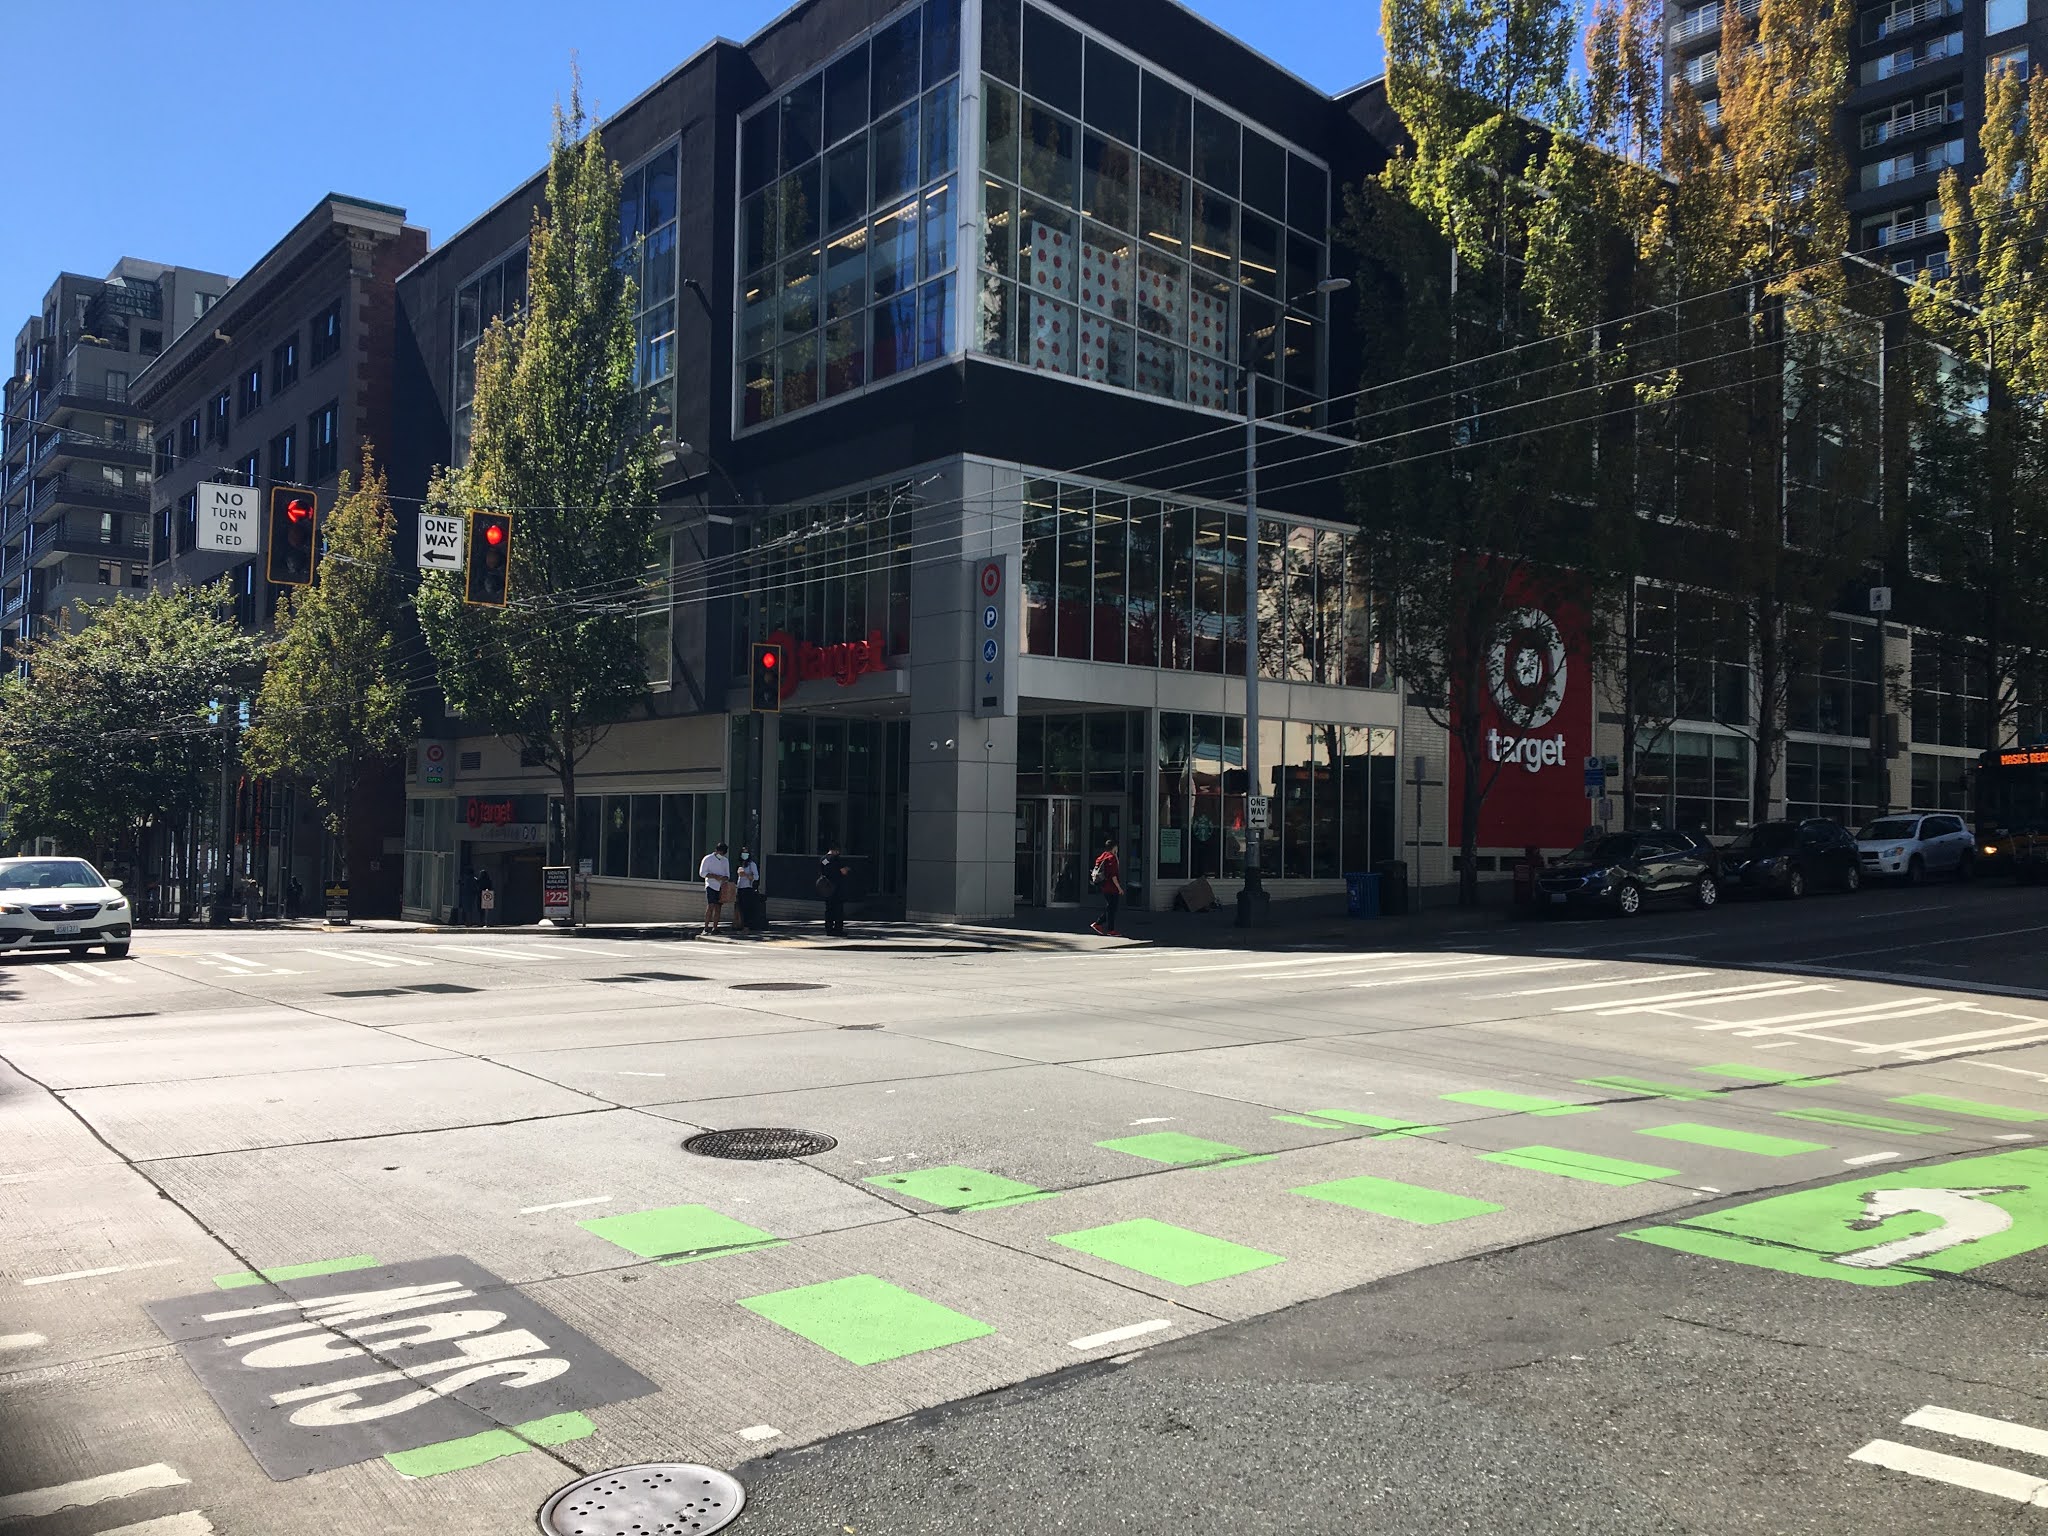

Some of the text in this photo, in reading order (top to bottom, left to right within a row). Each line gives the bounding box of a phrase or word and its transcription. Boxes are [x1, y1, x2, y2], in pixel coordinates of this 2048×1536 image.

[215, 491, 244, 506] NO
[211, 506, 247, 520] TURN
[219, 521, 238, 533] ON
[424, 519, 458, 534] ONE
[215, 534, 242, 546] RED
[425, 533, 459, 548] WAY
[986, 611, 995, 626] P
[799, 629, 888, 688] target
[1486, 727, 1567, 773] target
[2001, 754, 2028, 765] MASKS
[1250, 798, 1265, 806] ONE
[480, 801, 512, 826] target
[1250, 807, 1266, 815] WAY
[546, 891, 569, 903] $225
[201, 1281, 571, 1427] SLOW
